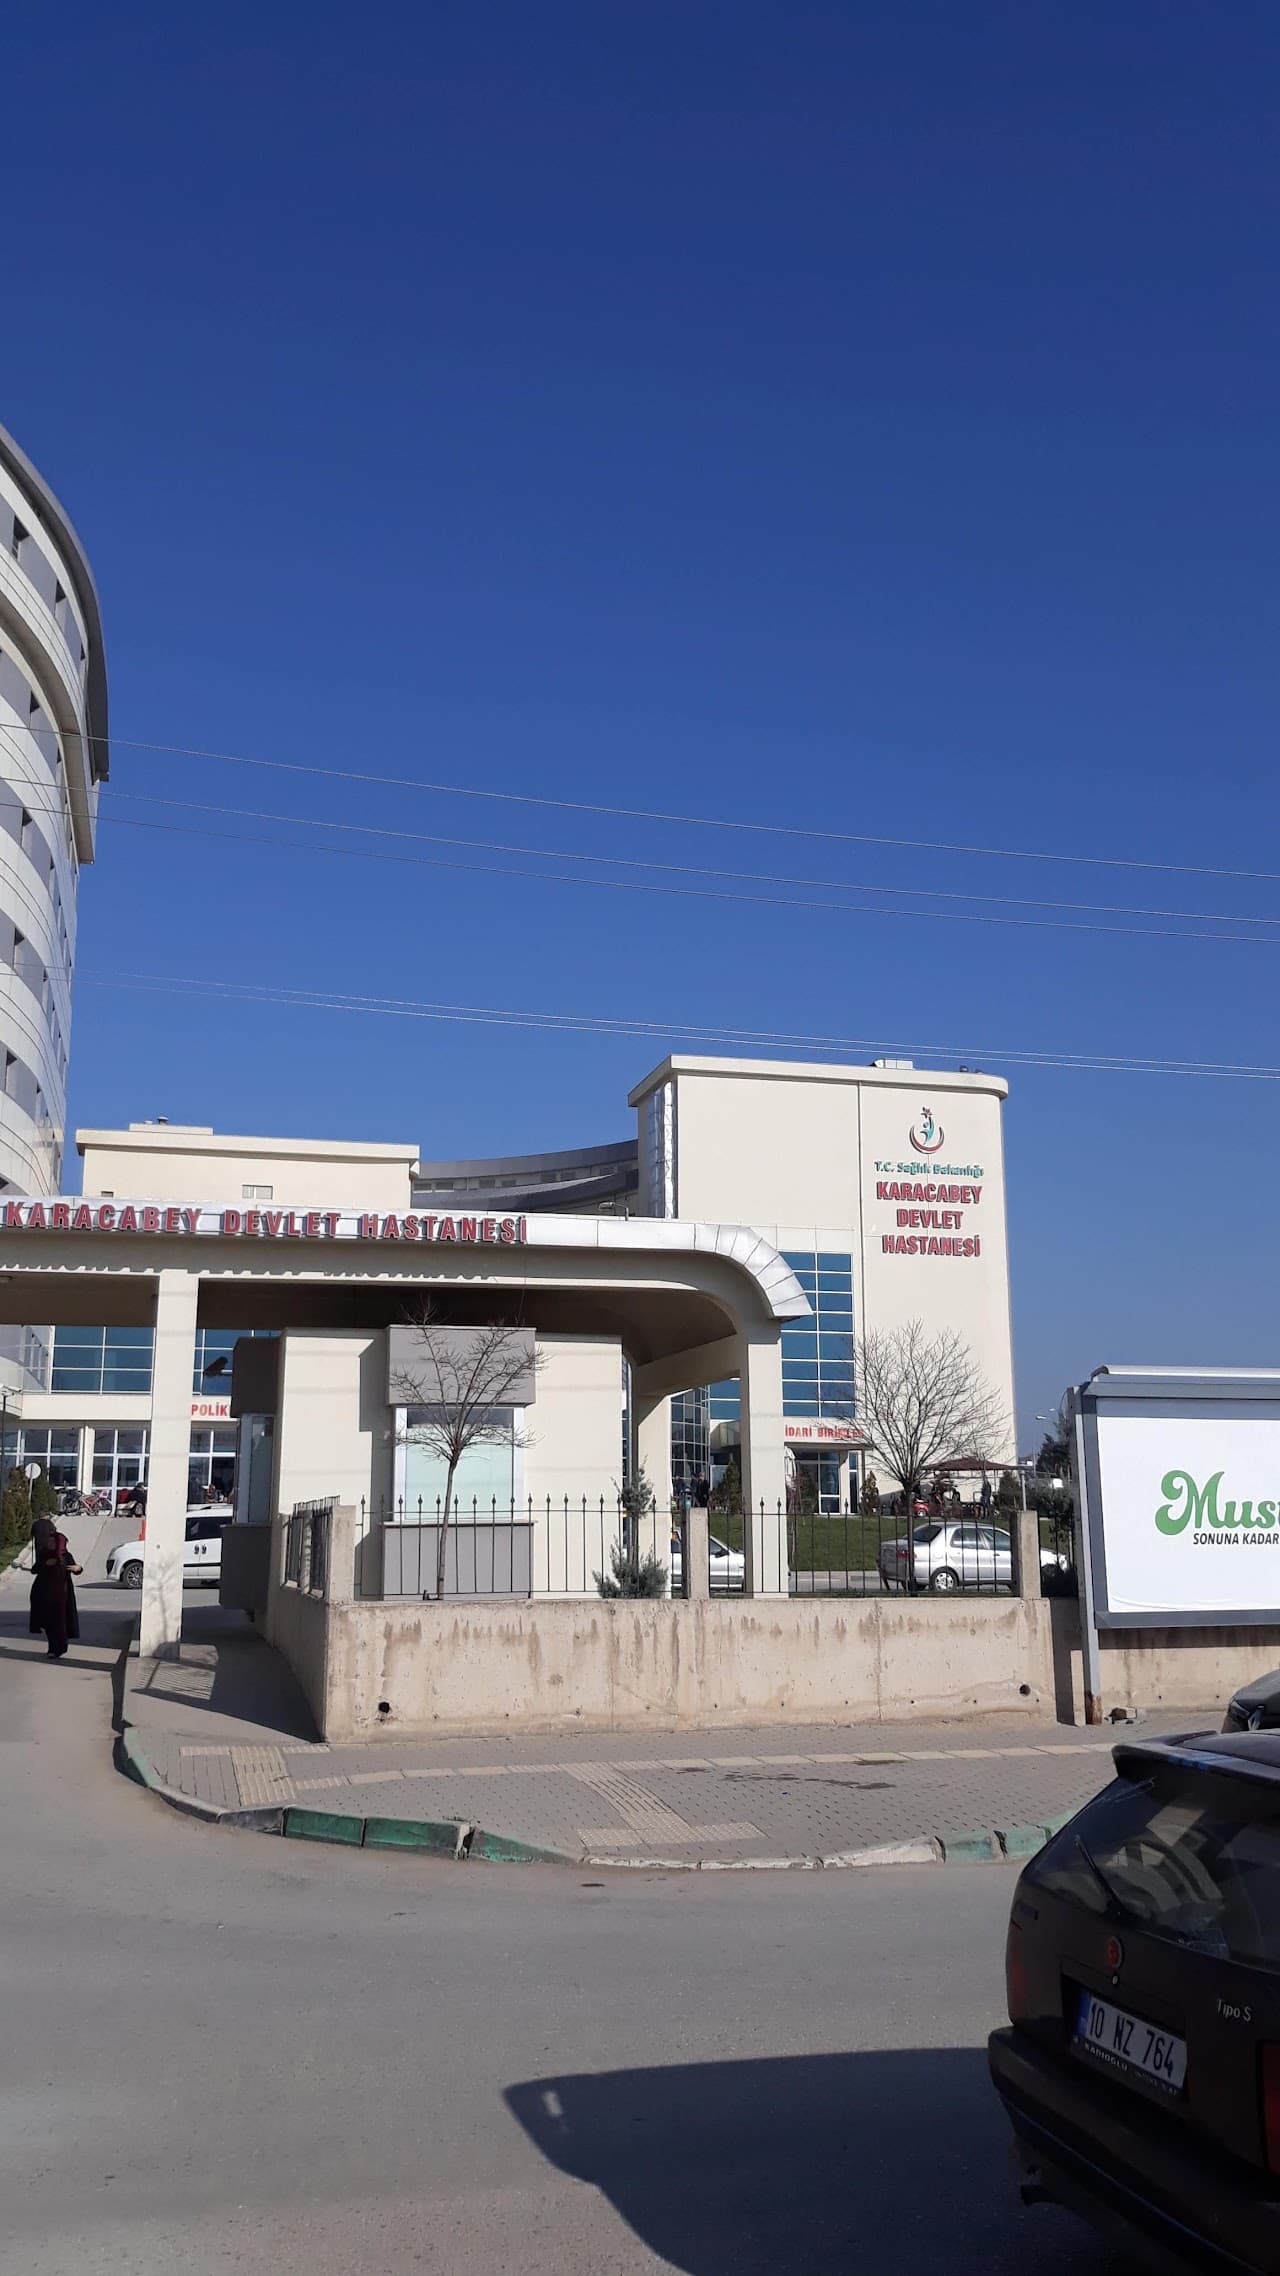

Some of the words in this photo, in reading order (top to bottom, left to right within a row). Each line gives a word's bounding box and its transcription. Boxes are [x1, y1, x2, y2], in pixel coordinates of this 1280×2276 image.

[874, 1161, 895, 1173] T.C.
[876, 1181, 982, 1205] KARACABEY
[6, 1200, 202, 1234] KARACABEY
[223, 1208, 342, 1237] DEVLET
[361, 1213, 528, 1245] HASTANESİ
[896, 1208, 964, 1230] DEVLET
[882, 1234, 981, 1258] HASTANESİ
[1154, 1469, 1280, 1536] Mus
[1193, 1532, 1240, 1545] SONUNA
[1242, 1532, 1280, 1545] KADAR
[1216, 1998, 1241, 2020] Tipo
[1242, 2005, 1253, 2022] S
[1088, 2001, 1106, 2040] 10
[1112, 2014, 1137, 2058] NZ
[1141, 2028, 1176, 2080] 764
